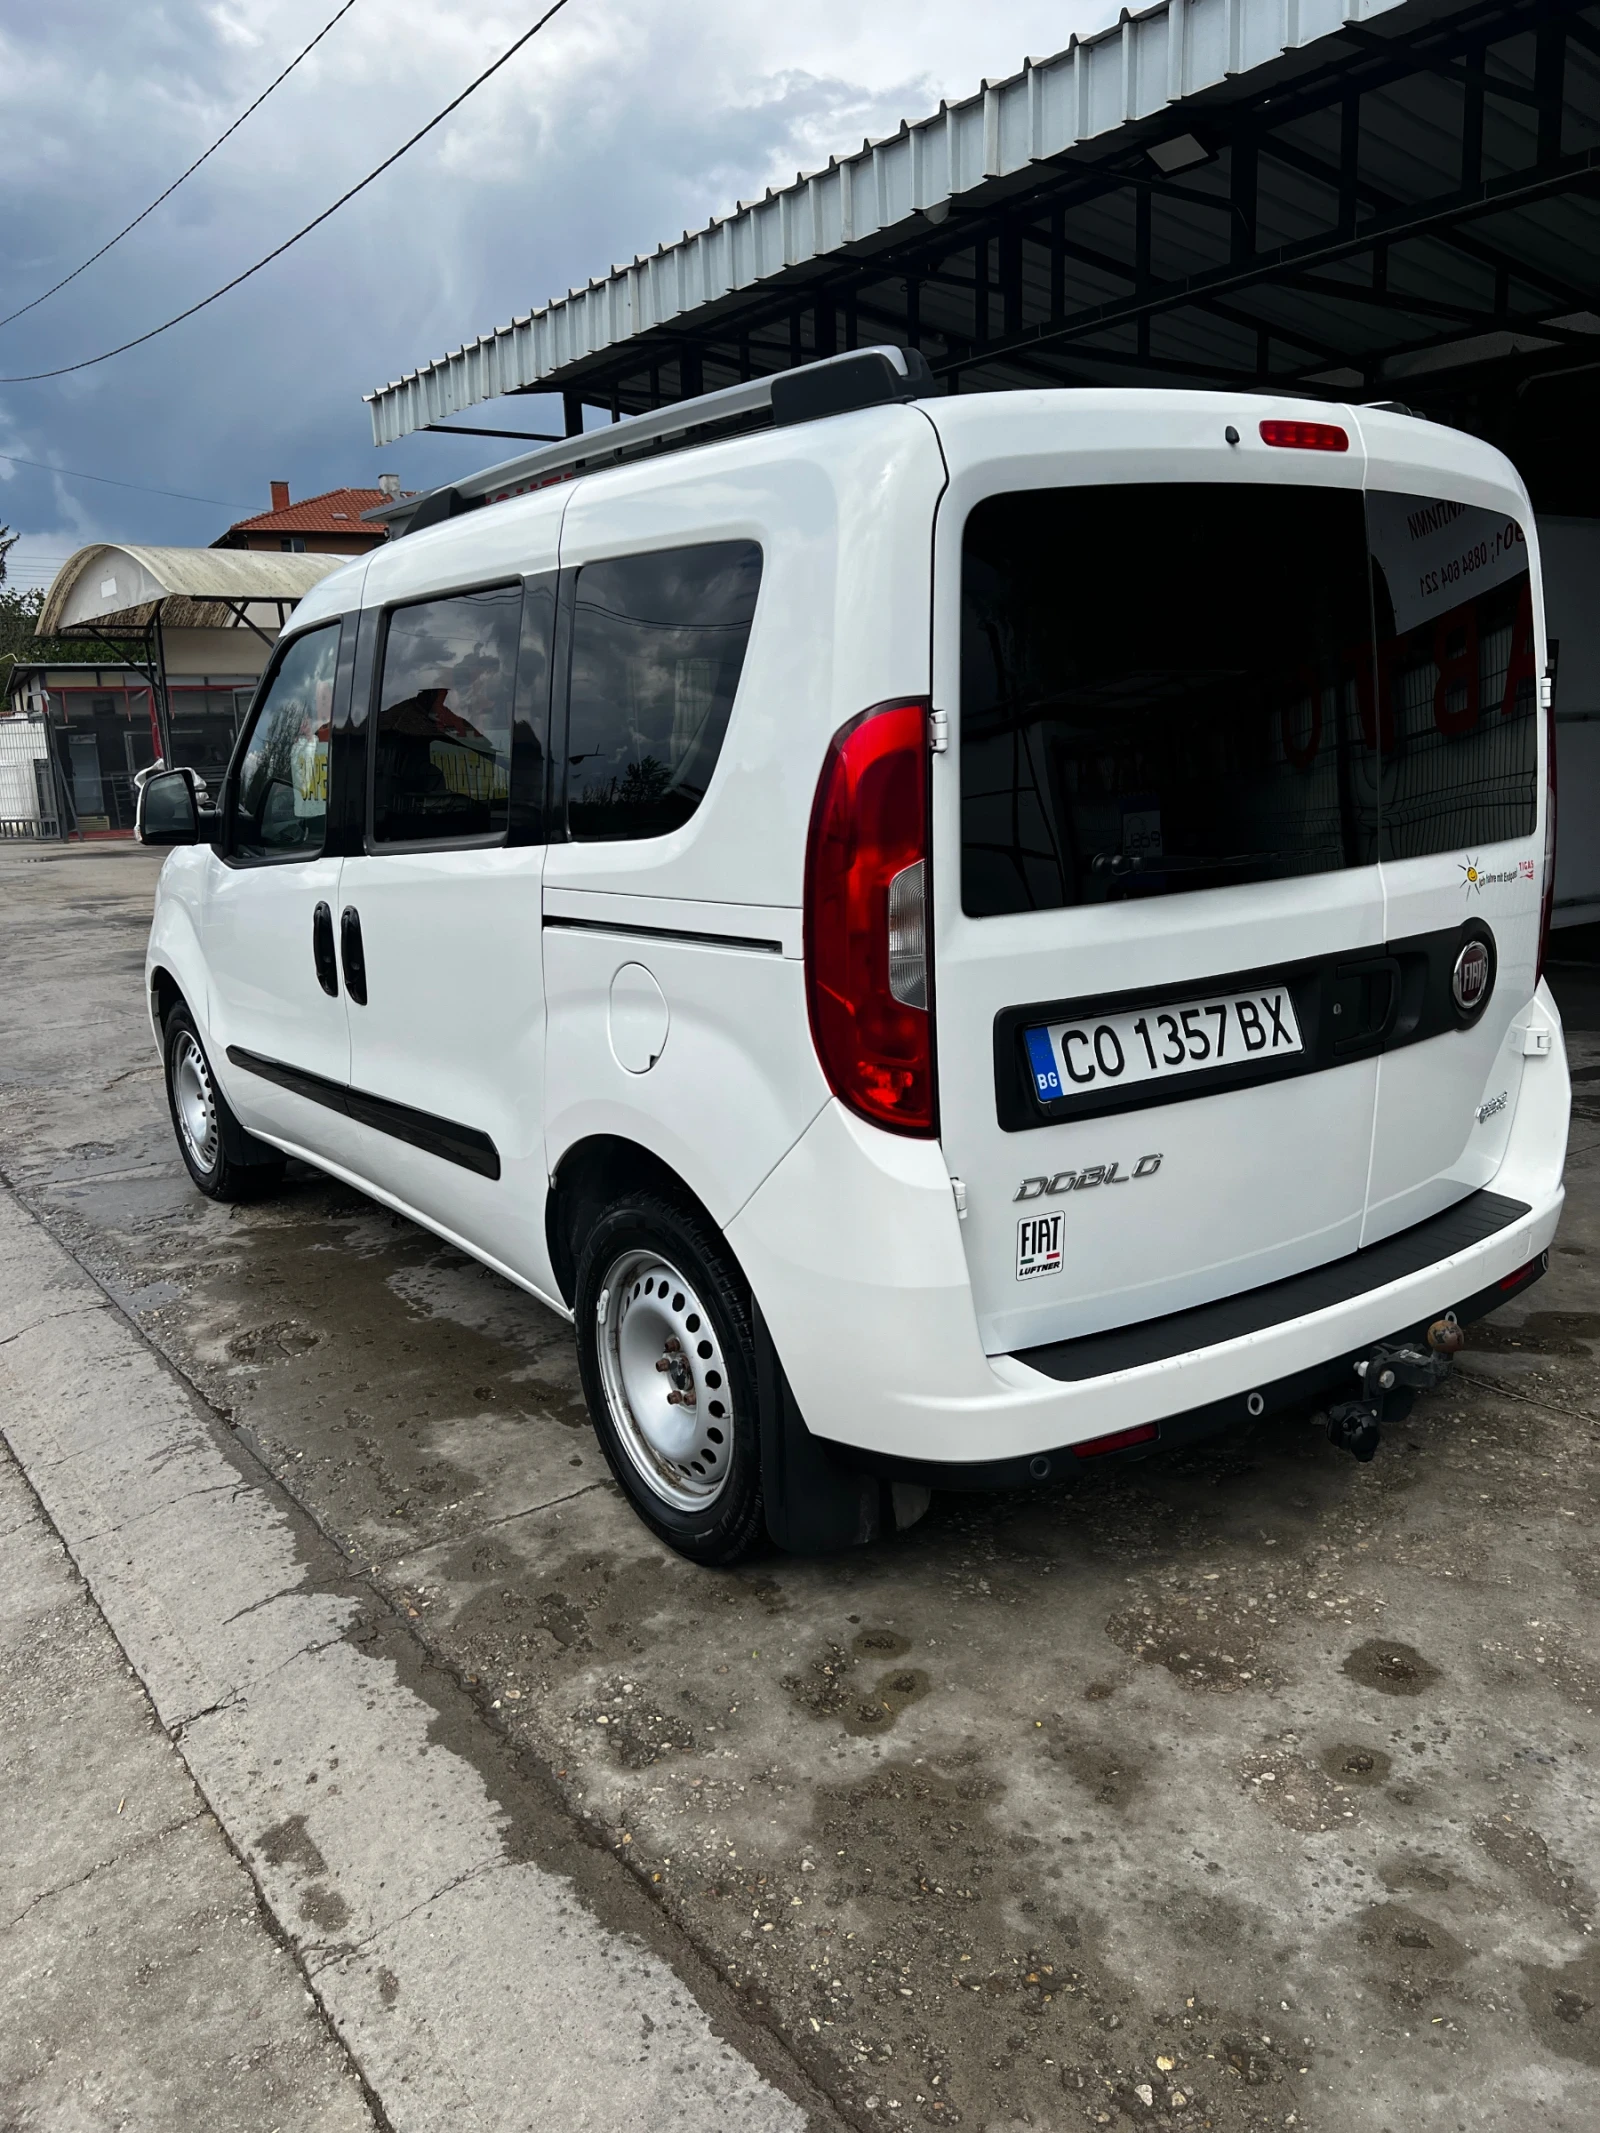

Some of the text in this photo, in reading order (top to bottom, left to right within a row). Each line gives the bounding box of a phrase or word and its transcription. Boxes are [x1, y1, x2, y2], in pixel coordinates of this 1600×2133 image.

[1519, 860, 1534, 871] TIGAS
[1463, 959, 1483, 992] FIAT
[1061, 995, 1293, 1083] CO 1357 BX
[1037, 1071, 1058, 1090] BG
[1021, 1216, 1062, 1257] FIAT
